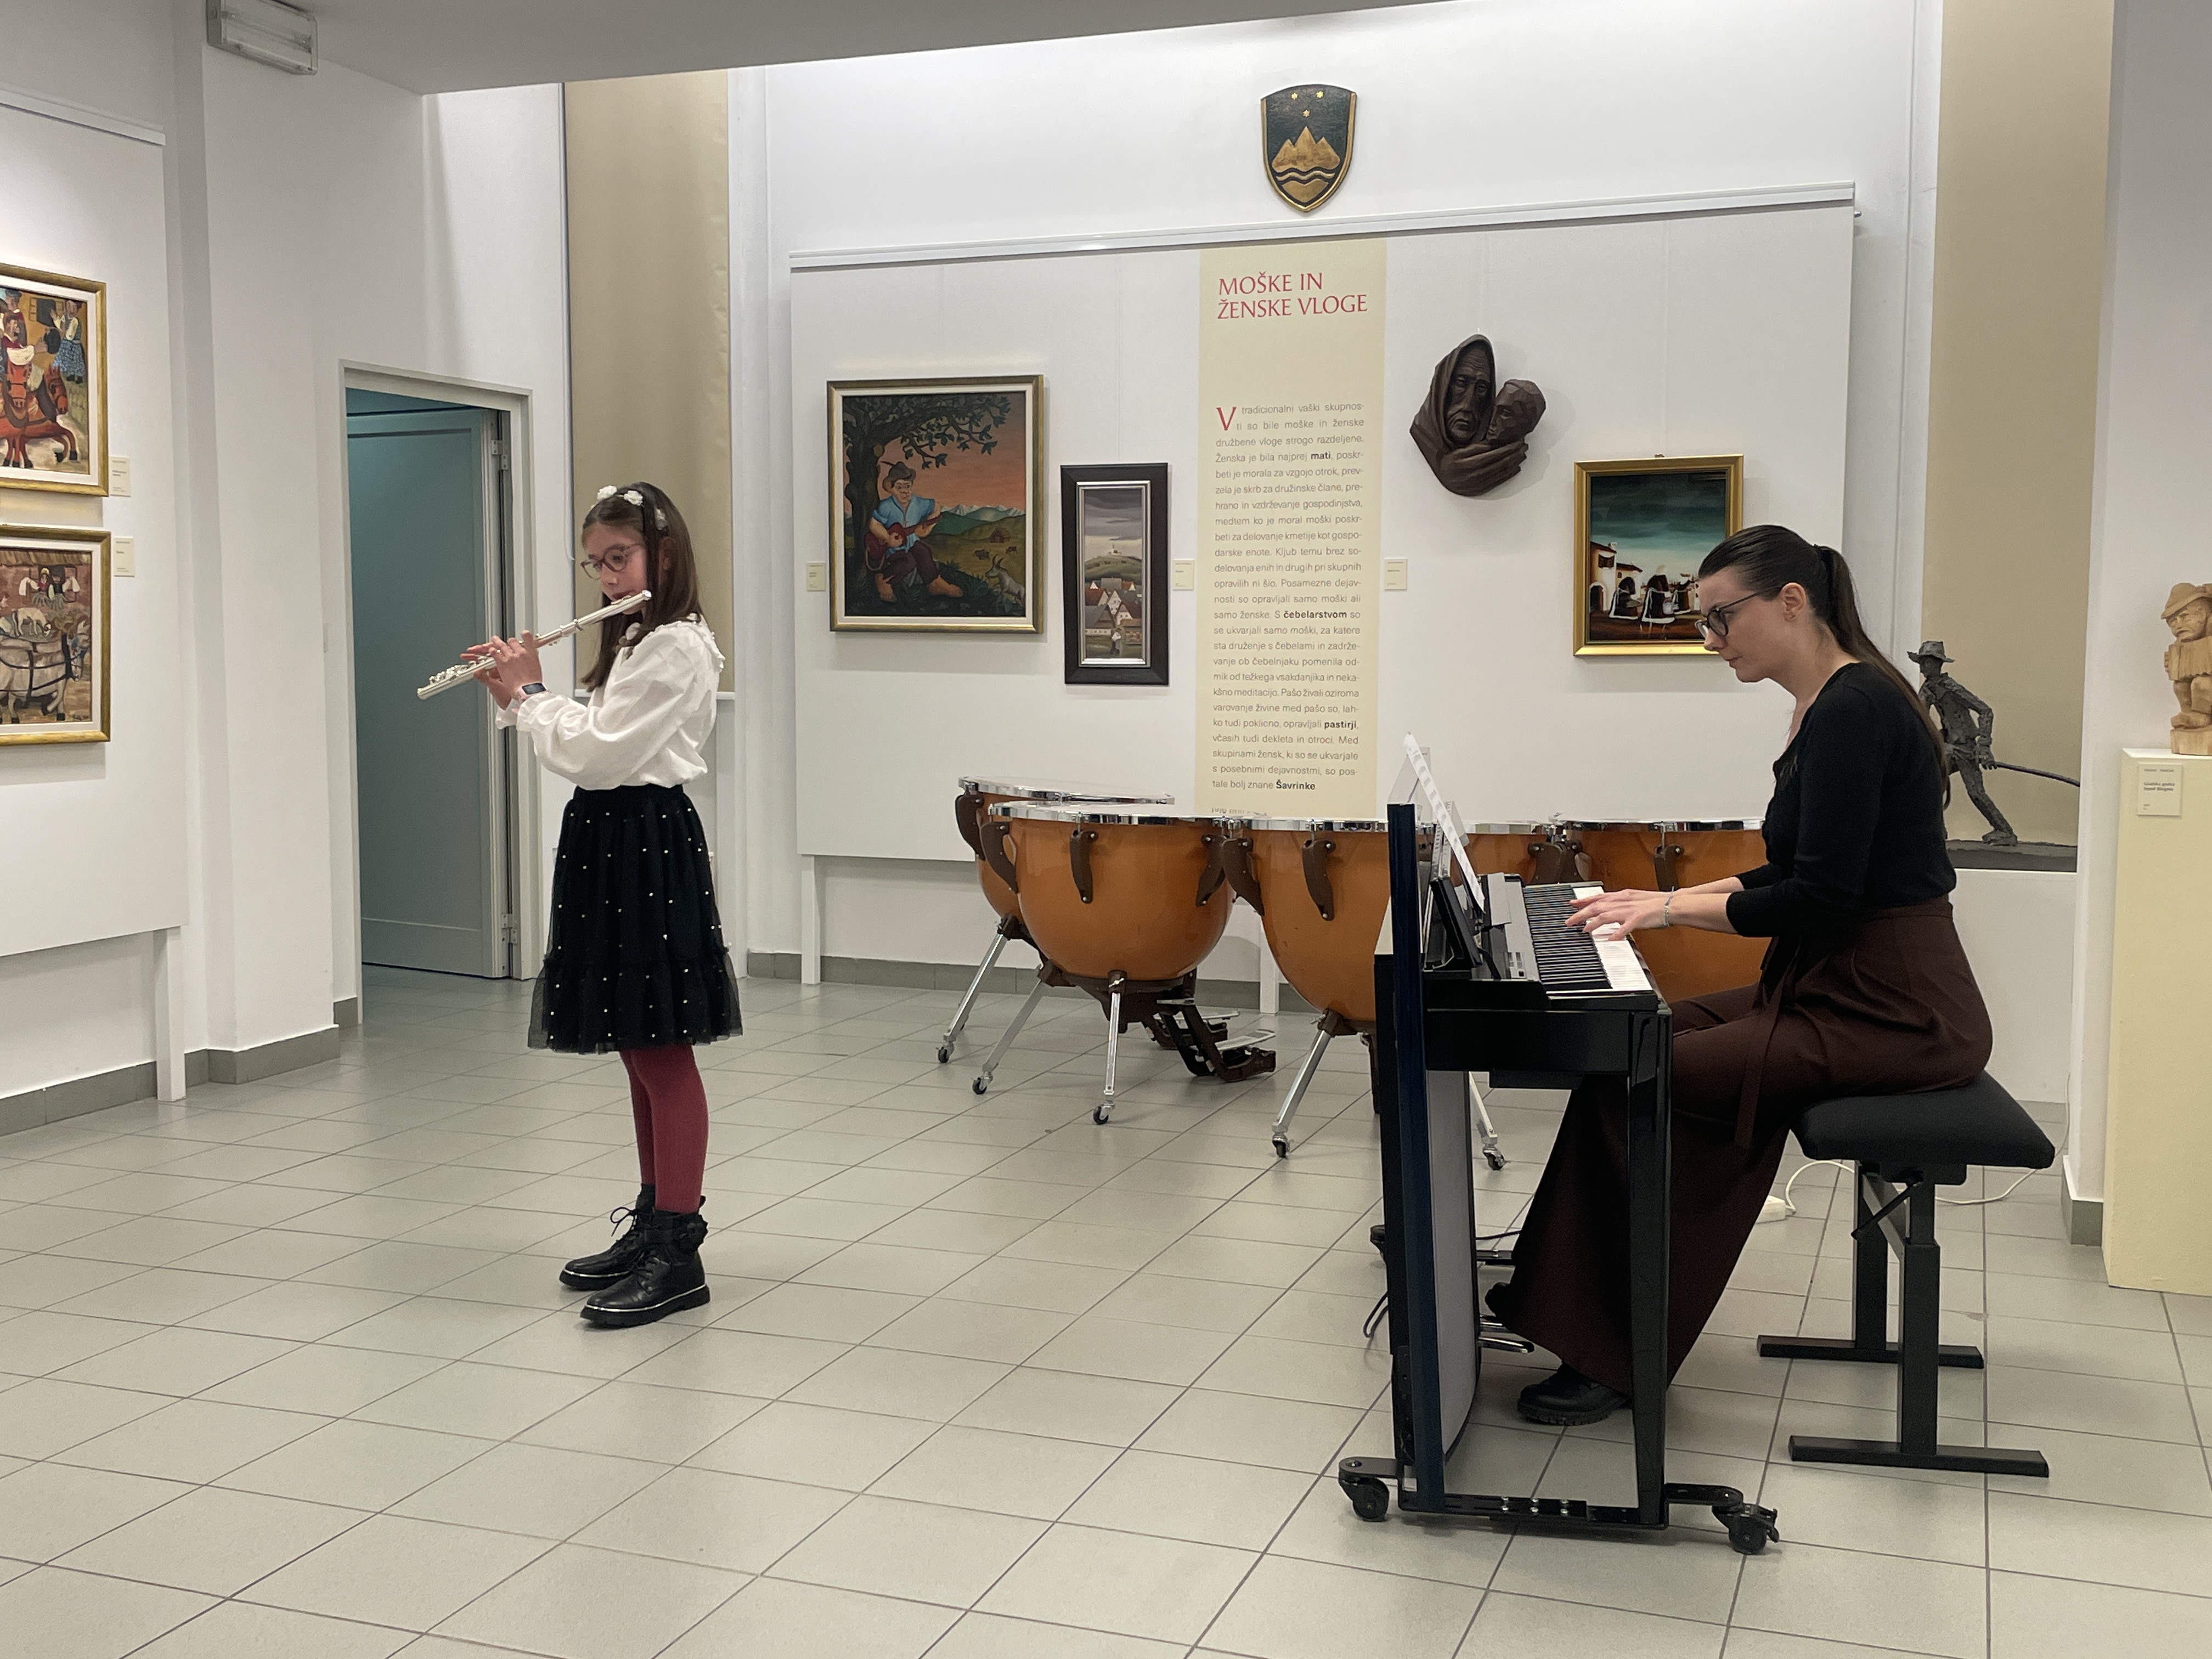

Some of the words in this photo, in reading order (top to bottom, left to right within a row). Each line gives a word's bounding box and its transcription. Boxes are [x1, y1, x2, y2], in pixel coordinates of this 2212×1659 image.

[1219, 271, 1293, 295] MOŠKE
[1300, 273, 1322, 290] IN
[1217, 298, 1292, 319] ŽENSKE
[1297, 295, 1368, 315] VLOGE
[1216, 407, 1237, 431] V
[1242, 405, 1294, 414] tradicionalni
[1299, 404, 1319, 412] vaški
[1285, 420, 1313, 428] moške
[1333, 419, 1364, 427] ženske
[1216, 438, 1256, 447] družbene
[1259, 437, 1282, 447] vloge
[1286, 438, 1313, 446] strogo
[1216, 453, 1245, 462] Ženska
[1278, 454, 1307, 462] najprej
[1243, 469, 1272, 477] morala
[1285, 470, 1313, 478] vzgojo
[1244, 485, 1261, 493] skrb
[1275, 484, 1316, 493] družinske
[1252, 500, 1300, 510] vzdrževanje
[1306, 515, 1331, 523] moški
[1243, 533, 1283, 541] delovanje
[1285, 532, 1316, 541] kmetije
[1276, 548, 1296, 557] Kljub
[1326, 547, 1344, 555] brez
[1215, 564, 1254, 573] delovanja
[1285, 563, 1312, 573] drugih
[1328, 563, 1361, 572] skupnih
[1214, 580, 1249, 589] opravilih
[1281, 579, 1331, 587] Posamezne
[1252, 595, 1290, 605] opravljali
[1274, 610, 1280, 619] S
[1283, 610, 1347, 618] čebelarstvom
[1227, 627, 1261, 635] ukvarjali
[1229, 641, 1266, 651] druženje
[1252, 657, 1299, 667] čebelnjaku
[1302, 658, 1342, 667] pomenila
[1242, 673, 1274, 682] težkega
[1276, 673, 1324, 682] vsakdanjika
[1281, 688, 1302, 697] Pašo
[1304, 704, 1325, 714] pašo
[1283, 720, 1321, 729] opravljali
[1339, 736, 1358, 744] Med
[1213, 749, 1255, 758] skupinami
[1319, 752, 1358, 761] ukvarjale
[1231, 780, 1245, 789] bolj
